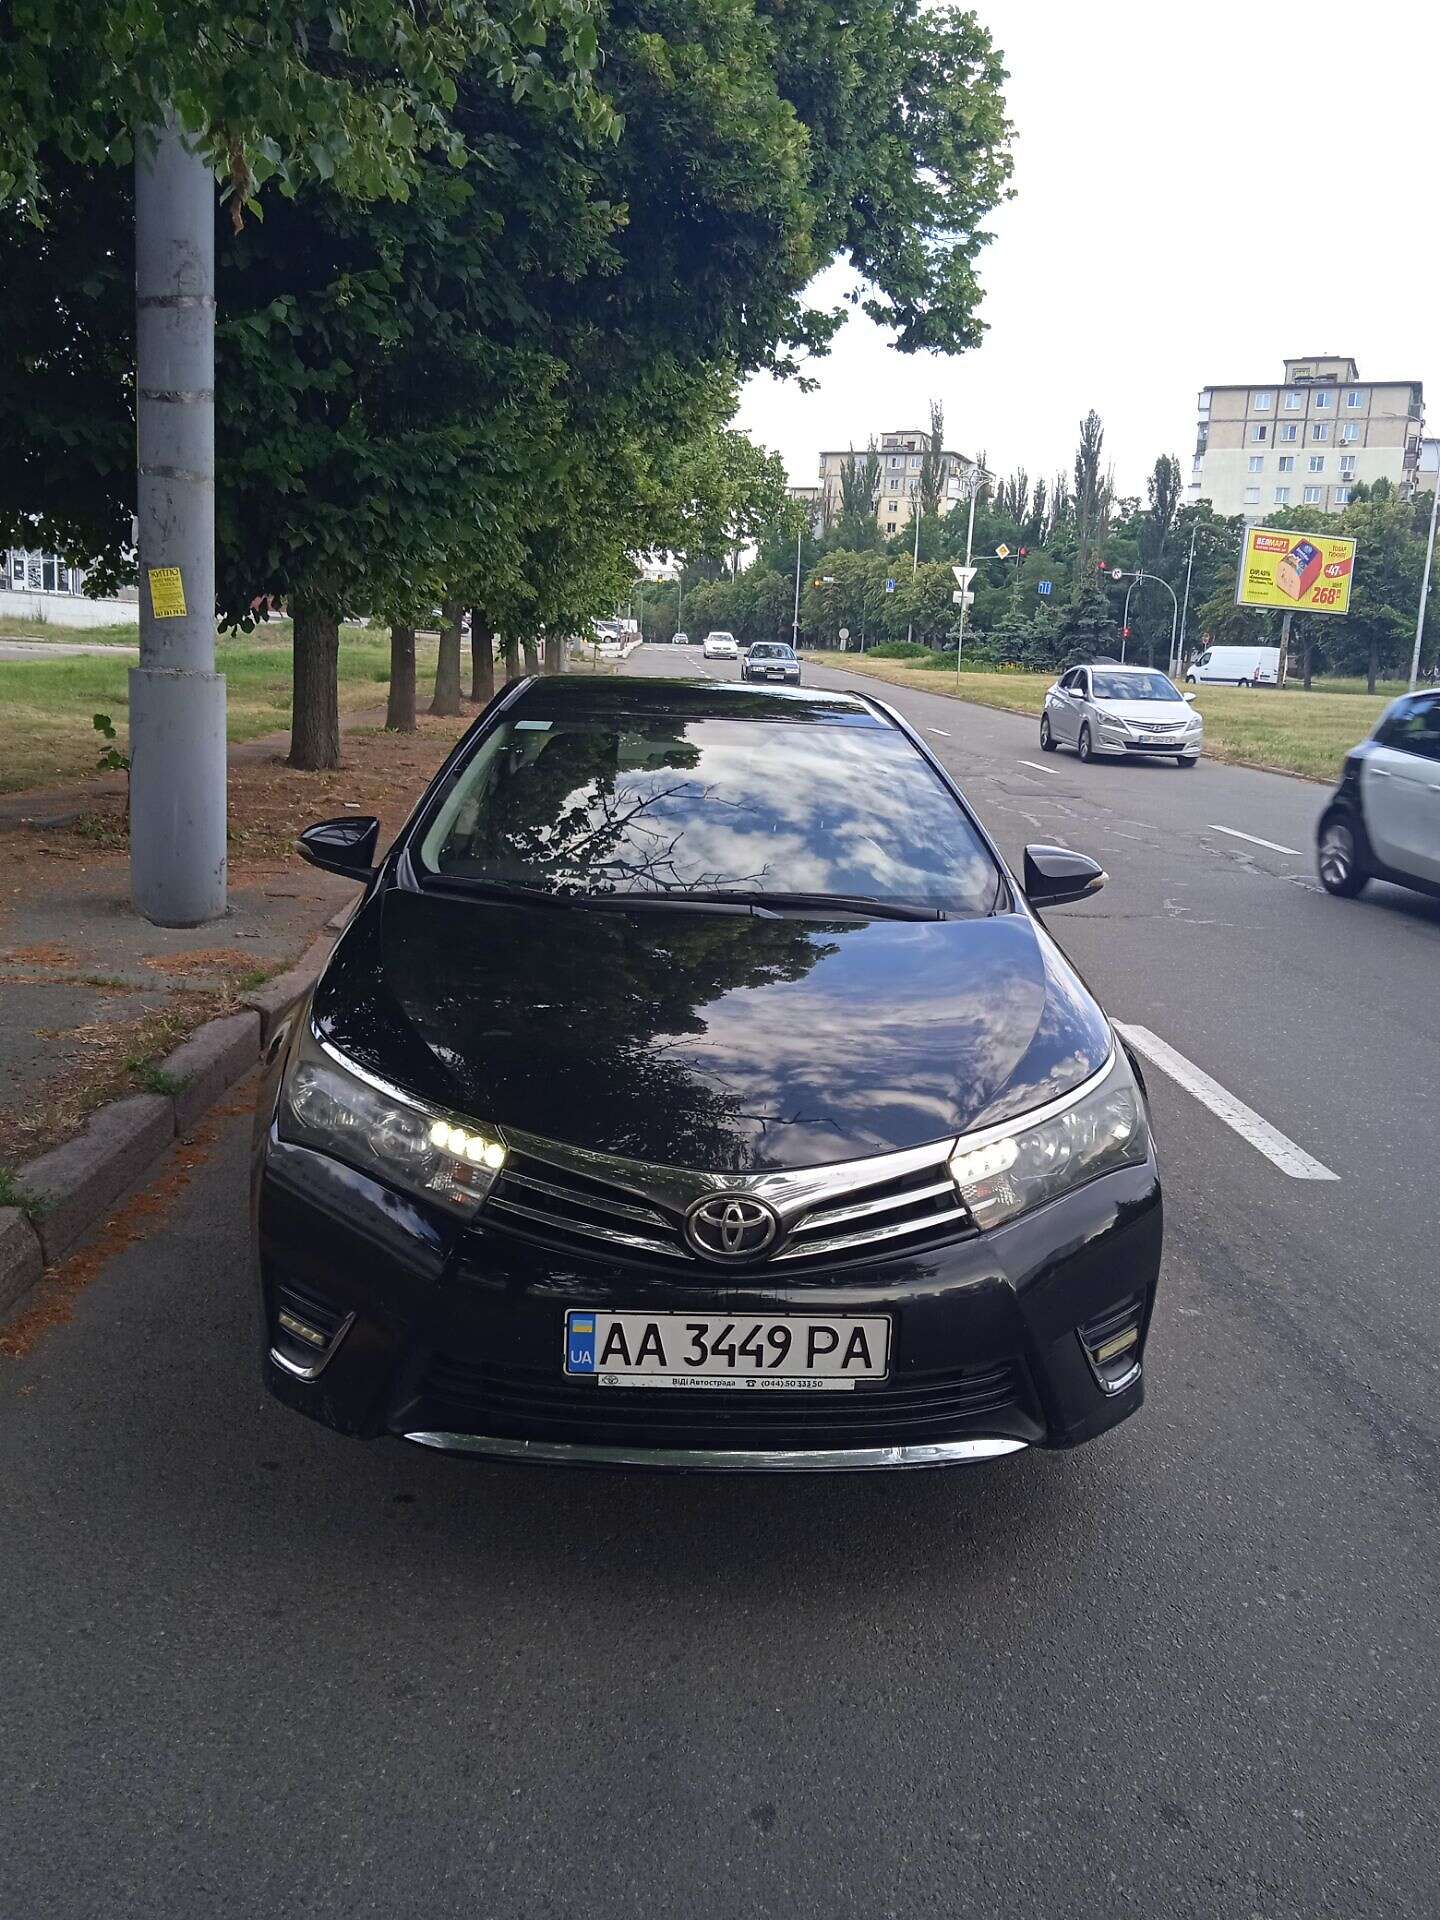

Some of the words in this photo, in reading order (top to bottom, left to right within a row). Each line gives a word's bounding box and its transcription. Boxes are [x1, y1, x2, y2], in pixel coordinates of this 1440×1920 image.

[1312, 587, 1337, 604] 268
[600, 1323, 667, 1366] AA
[683, 1324, 792, 1368] 3449
[807, 1325, 873, 1369] PA
[571, 1351, 592, 1364] UA
[689, 1379, 736, 1387] Автострада
